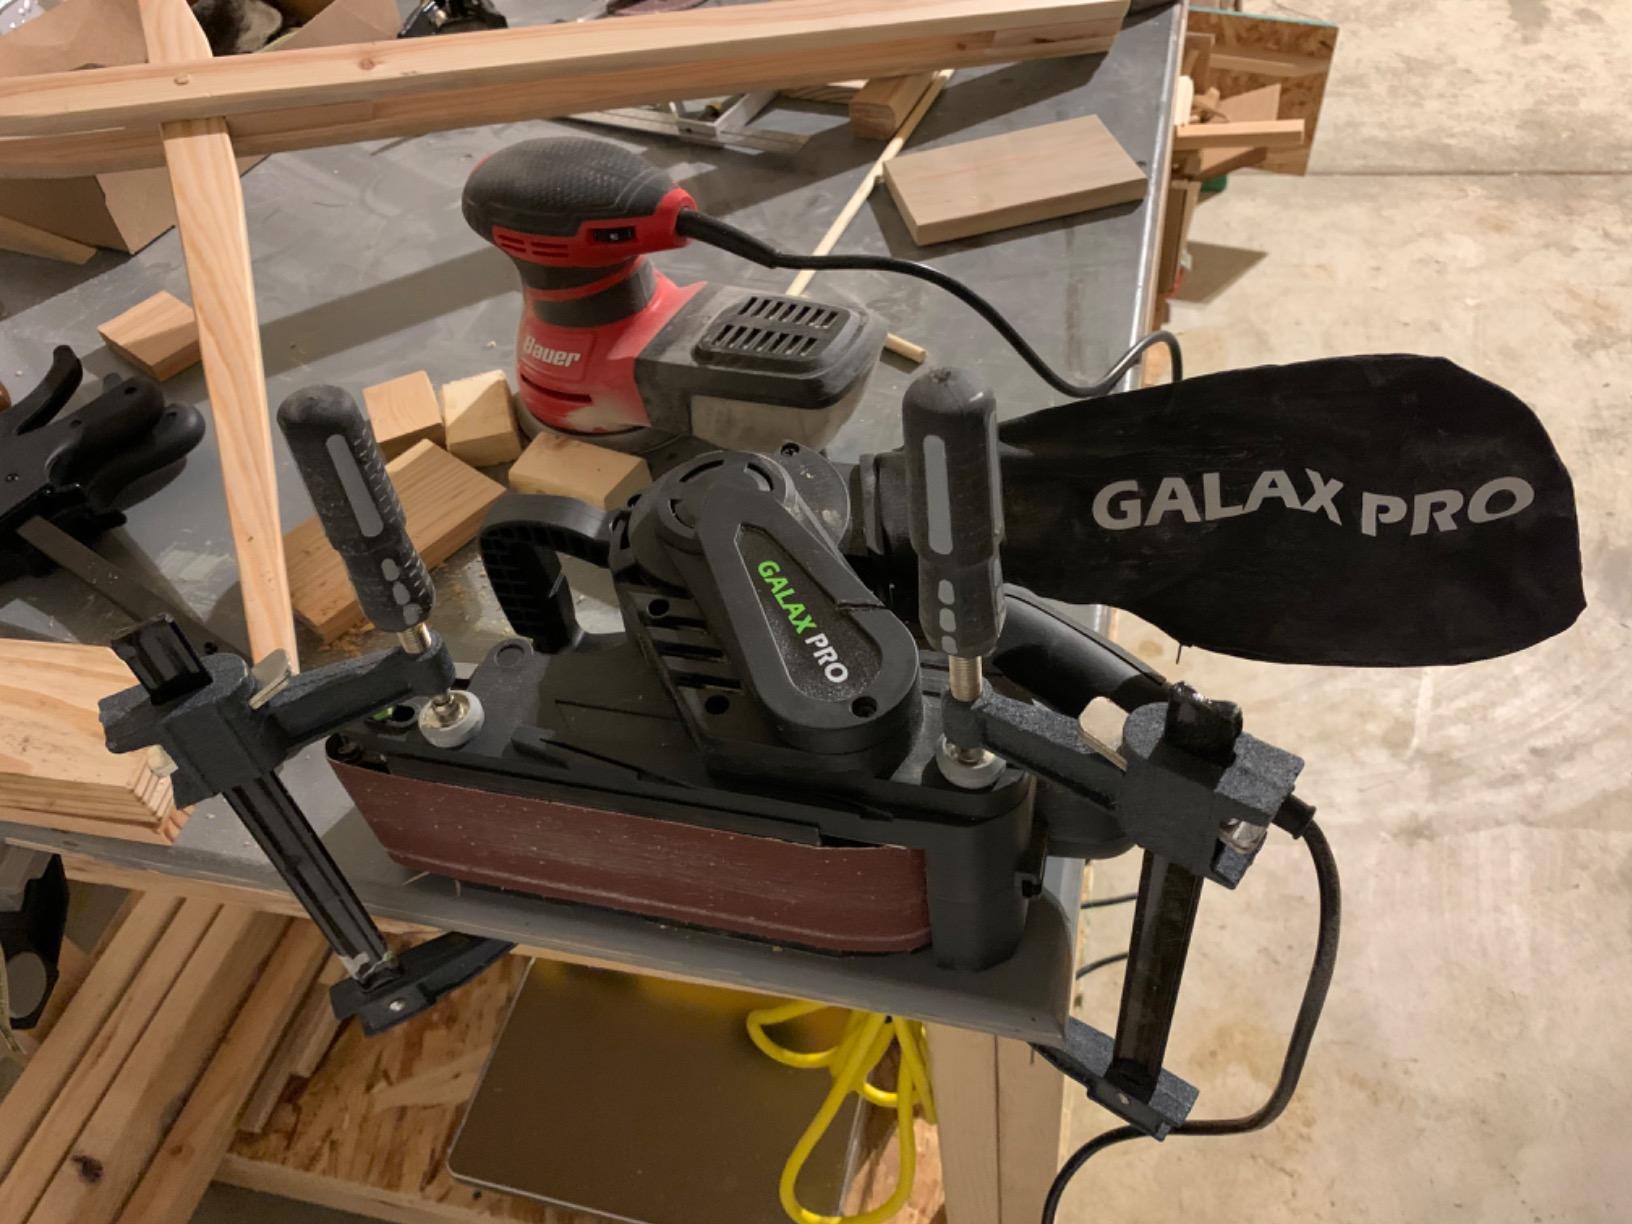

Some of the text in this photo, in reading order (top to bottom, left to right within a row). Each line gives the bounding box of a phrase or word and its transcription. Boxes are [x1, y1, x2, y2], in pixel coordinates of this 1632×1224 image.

[523, 336, 581, 367] Bauer
[1091, 468, 1535, 536] GALAX PRO
[757, 560, 849, 683] GALAX PRO
